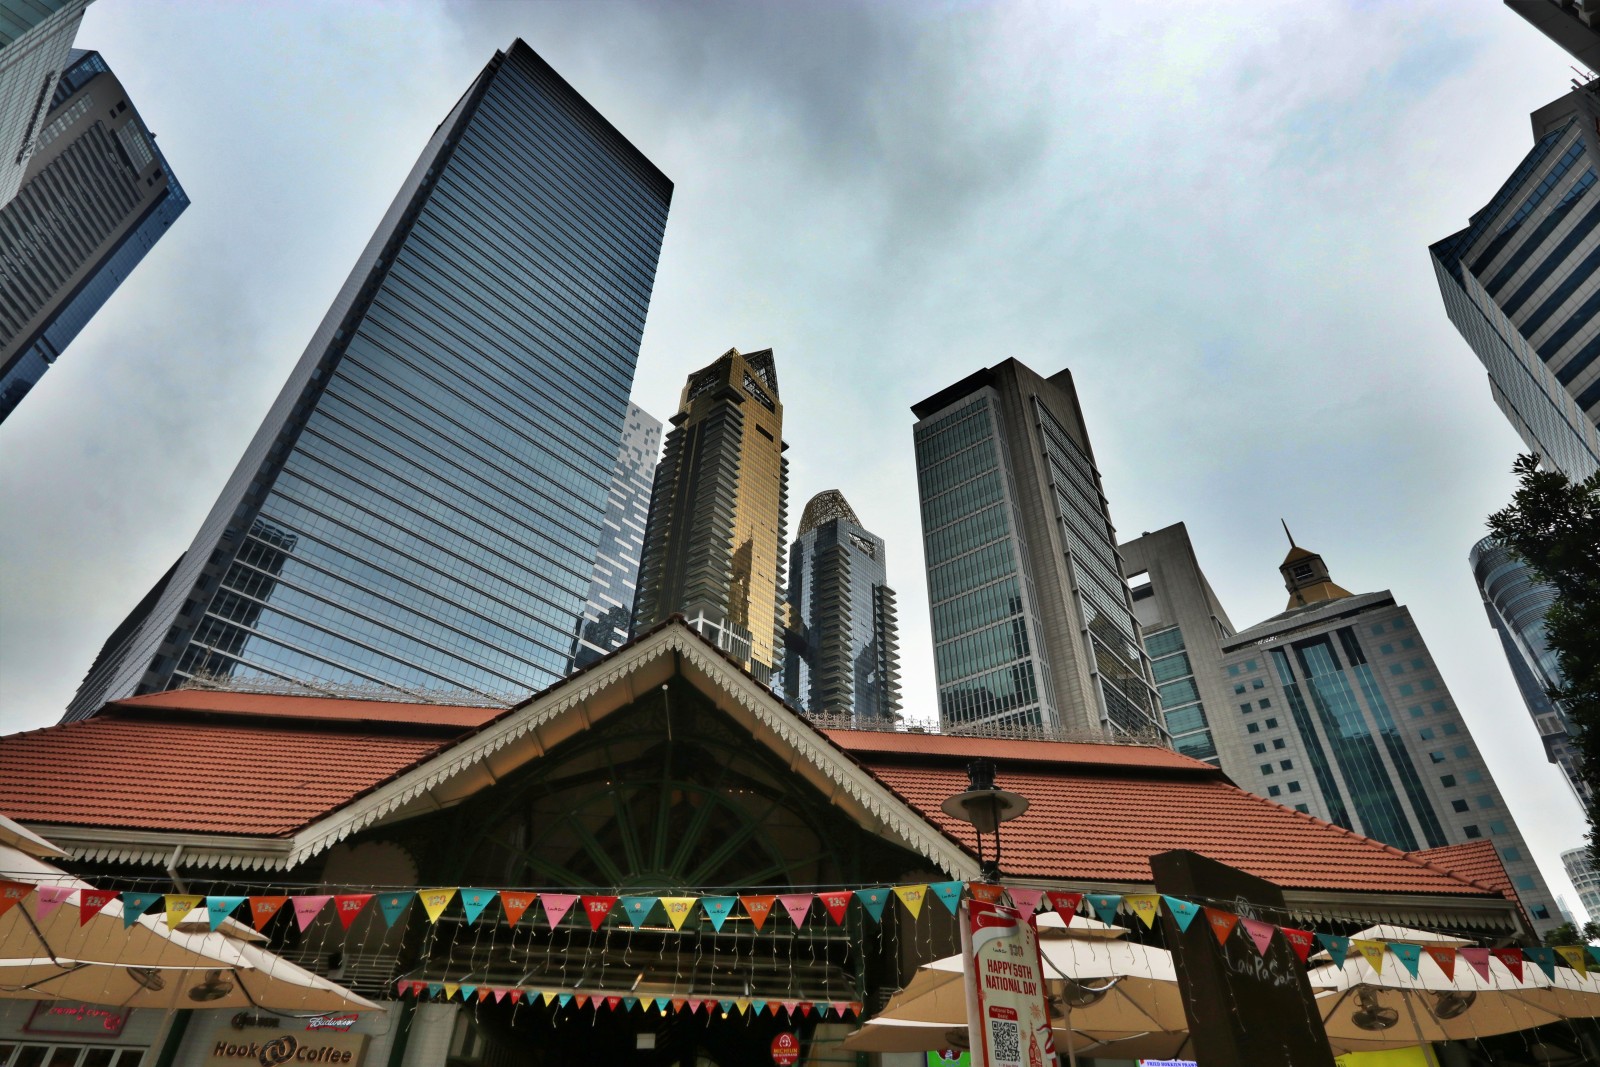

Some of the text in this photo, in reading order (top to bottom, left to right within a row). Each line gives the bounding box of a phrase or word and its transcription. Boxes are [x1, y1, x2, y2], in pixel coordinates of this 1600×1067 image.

[987, 959, 1033, 979] HAPPY 59TH
[985, 975, 1037, 996] NATIONAL DAY
[310, 1017, 355, 1027] Budweiser
[213, 1041, 353, 1063] Hook Coffee
